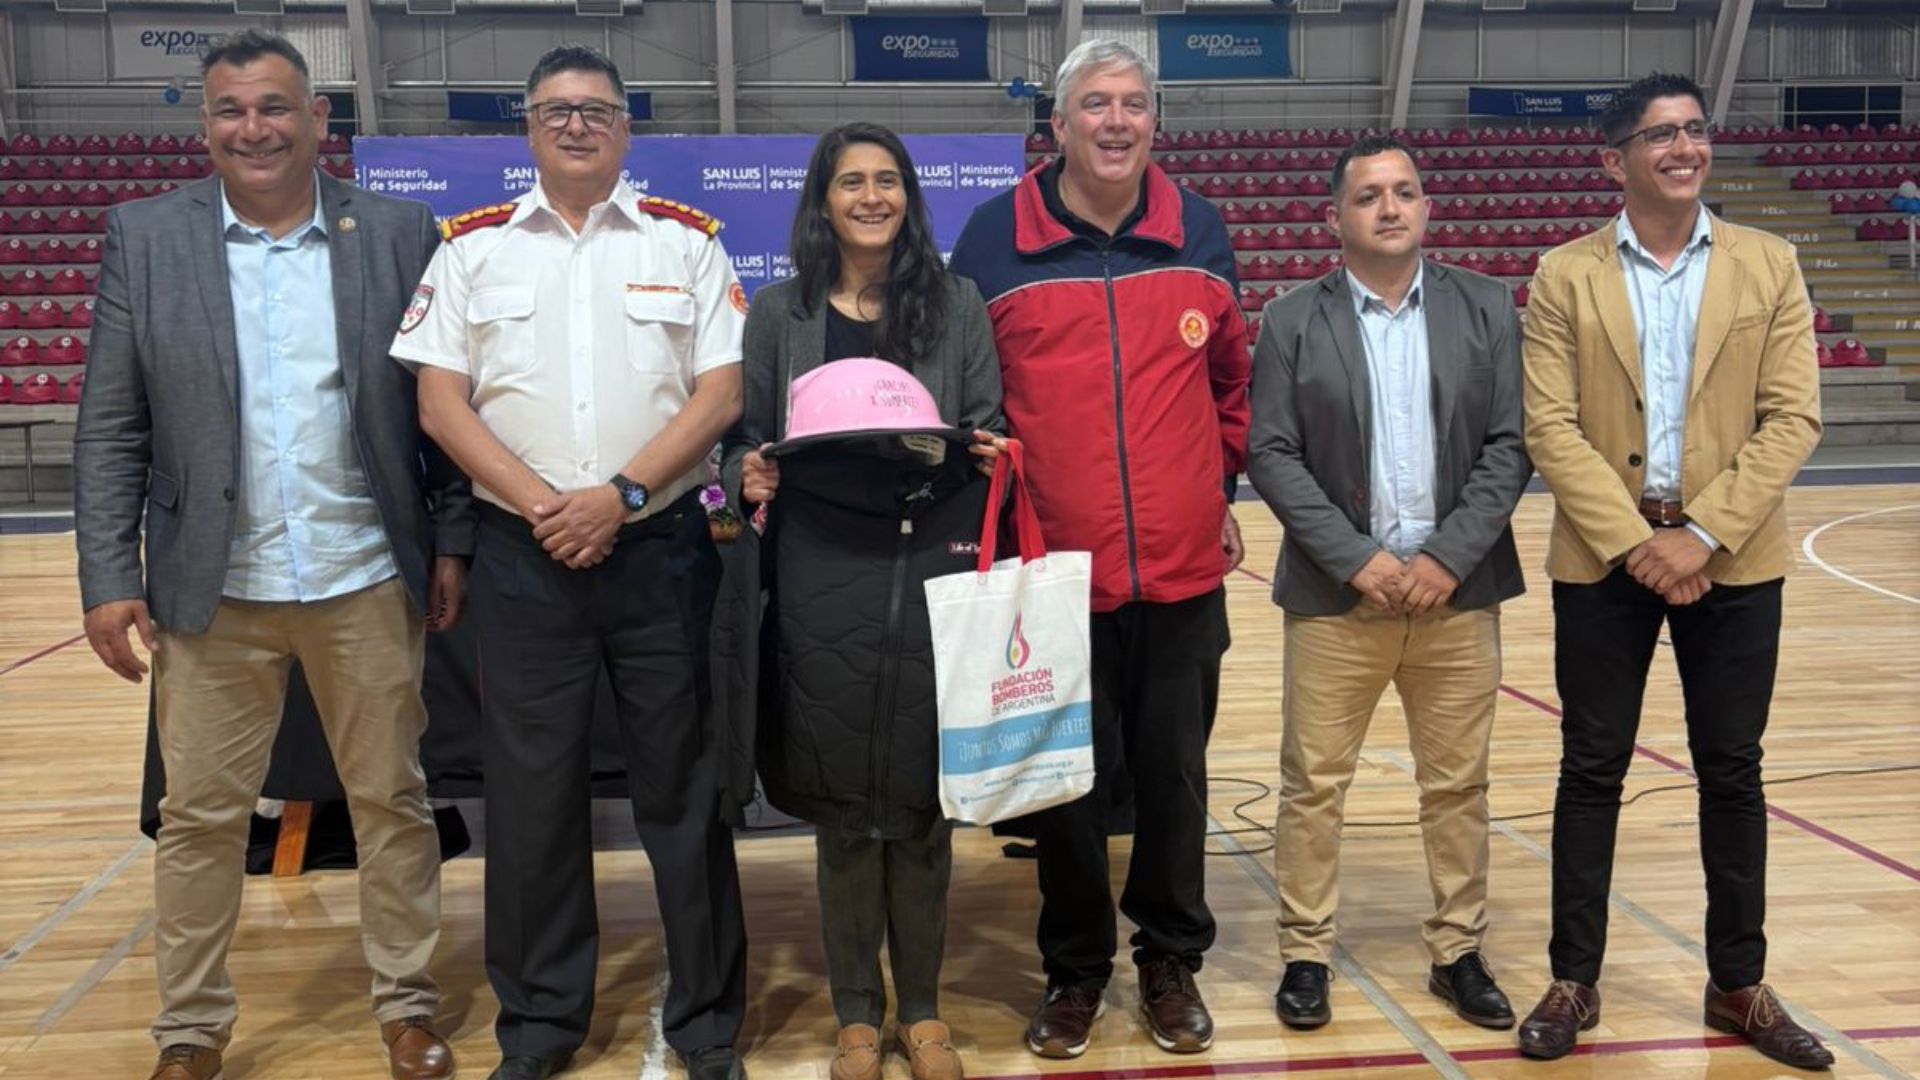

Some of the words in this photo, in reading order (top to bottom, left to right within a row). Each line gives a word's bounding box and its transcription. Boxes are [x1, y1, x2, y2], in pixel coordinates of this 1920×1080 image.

[141, 30, 196, 55] expo
[882, 34, 930, 57] expo
[1187, 34, 1234, 55] expo
[369, 167, 429, 179] Ministerio
[503, 168, 532, 179] SAN
[703, 168, 731, 179] SAN
[733, 168, 761, 179] LUIS
[769, 167, 808, 177] Minist
[924, 165, 952, 177] LUIS
[960, 164, 1014, 175] Ministerio
[369, 180, 387, 191] de
[388, 179, 448, 192] Seguridad
[504, 181, 517, 190] La
[703, 181, 715, 190] La
[717, 181, 762, 190] Provincia
[770, 179, 784, 190] de
[961, 177, 974, 186] de
[736, 255, 764, 267] LUIS
[773, 267, 787, 277] de
[991, 667, 1053, 692] FUNDACIÓN
[991, 680, 1055, 706] BOMBEROS
[1002, 694, 1055, 712] ARGENTINA
